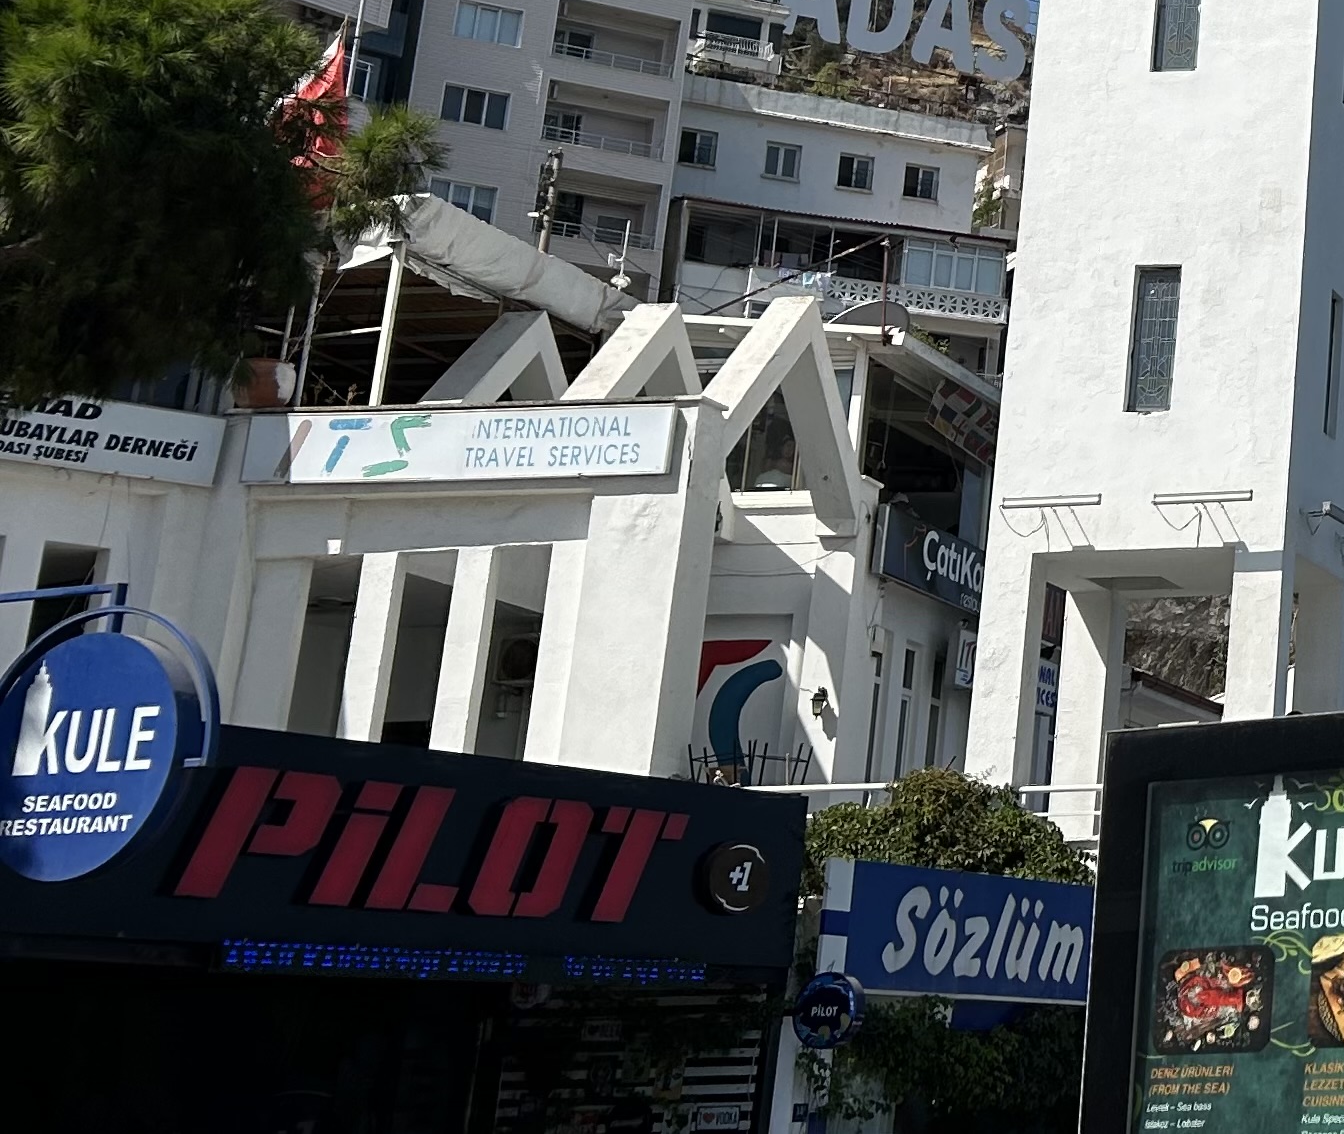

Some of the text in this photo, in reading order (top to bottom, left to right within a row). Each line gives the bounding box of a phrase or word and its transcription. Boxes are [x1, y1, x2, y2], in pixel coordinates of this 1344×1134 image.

[472, 416, 632, 440] INTERNATIONAL
[33, 445, 89, 464] ŞUBESİ
[104, 434, 199, 463] DERNEĞİ
[465, 443, 641, 469] TRAVEL SERVICES
[12, 660, 161, 776] KULE
[22, 792, 117, 814] SEAFOOD
[0, 813, 133, 837] RESTAURANT
[1172, 855, 1239, 877] tripadvisor
[882, 885, 1084, 985] Sözlüm
[1182, 1082, 1201, 1095] THE
[1203, 1081, 1231, 1096] SEA)
